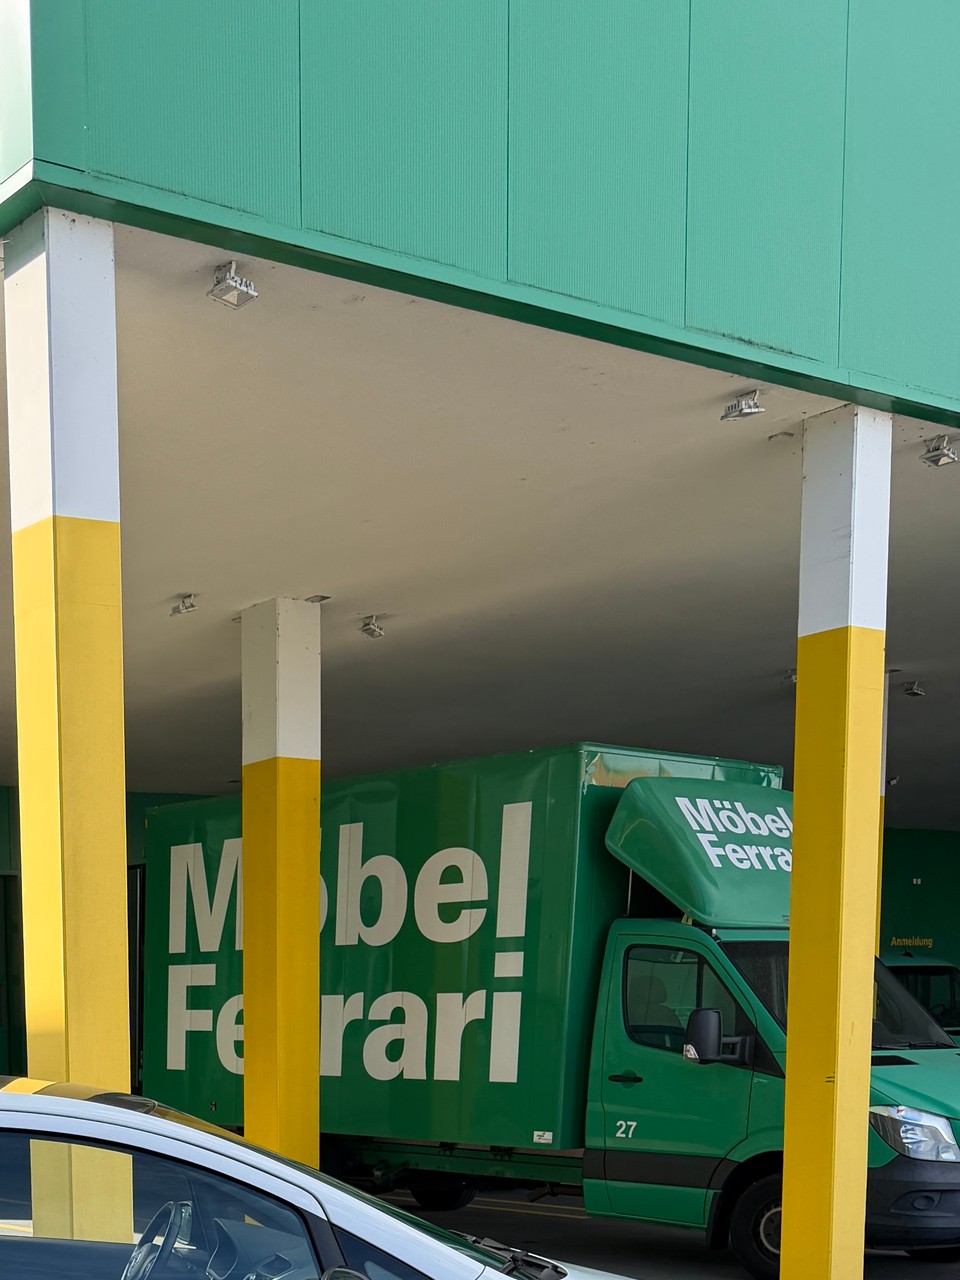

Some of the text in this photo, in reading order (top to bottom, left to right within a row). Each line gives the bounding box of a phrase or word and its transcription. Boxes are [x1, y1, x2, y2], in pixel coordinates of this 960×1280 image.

[674, 796, 794, 839] Möbel
[695, 832, 793, 873] Ferra
[167, 801, 533, 955] Mbel
[890, 935, 933, 949] Anmeldung
[615, 1120, 637, 1139] 27
